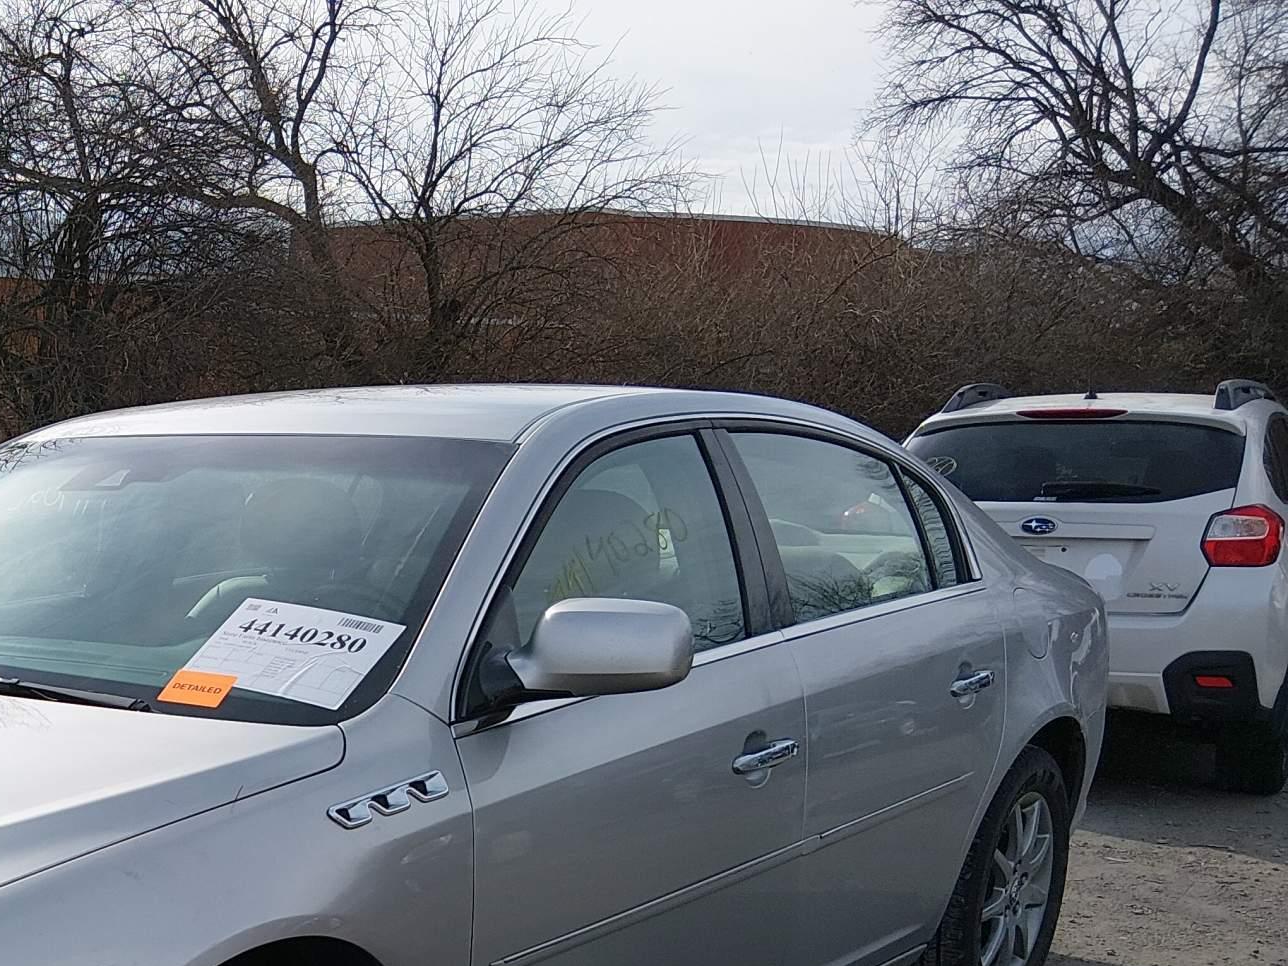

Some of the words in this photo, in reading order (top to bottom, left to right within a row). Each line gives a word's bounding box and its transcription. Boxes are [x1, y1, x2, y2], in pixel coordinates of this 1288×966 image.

[1149, 582, 1180, 591] XV
[239, 619, 367, 653] 44140280
[172, 682, 223, 695] DETAILED
